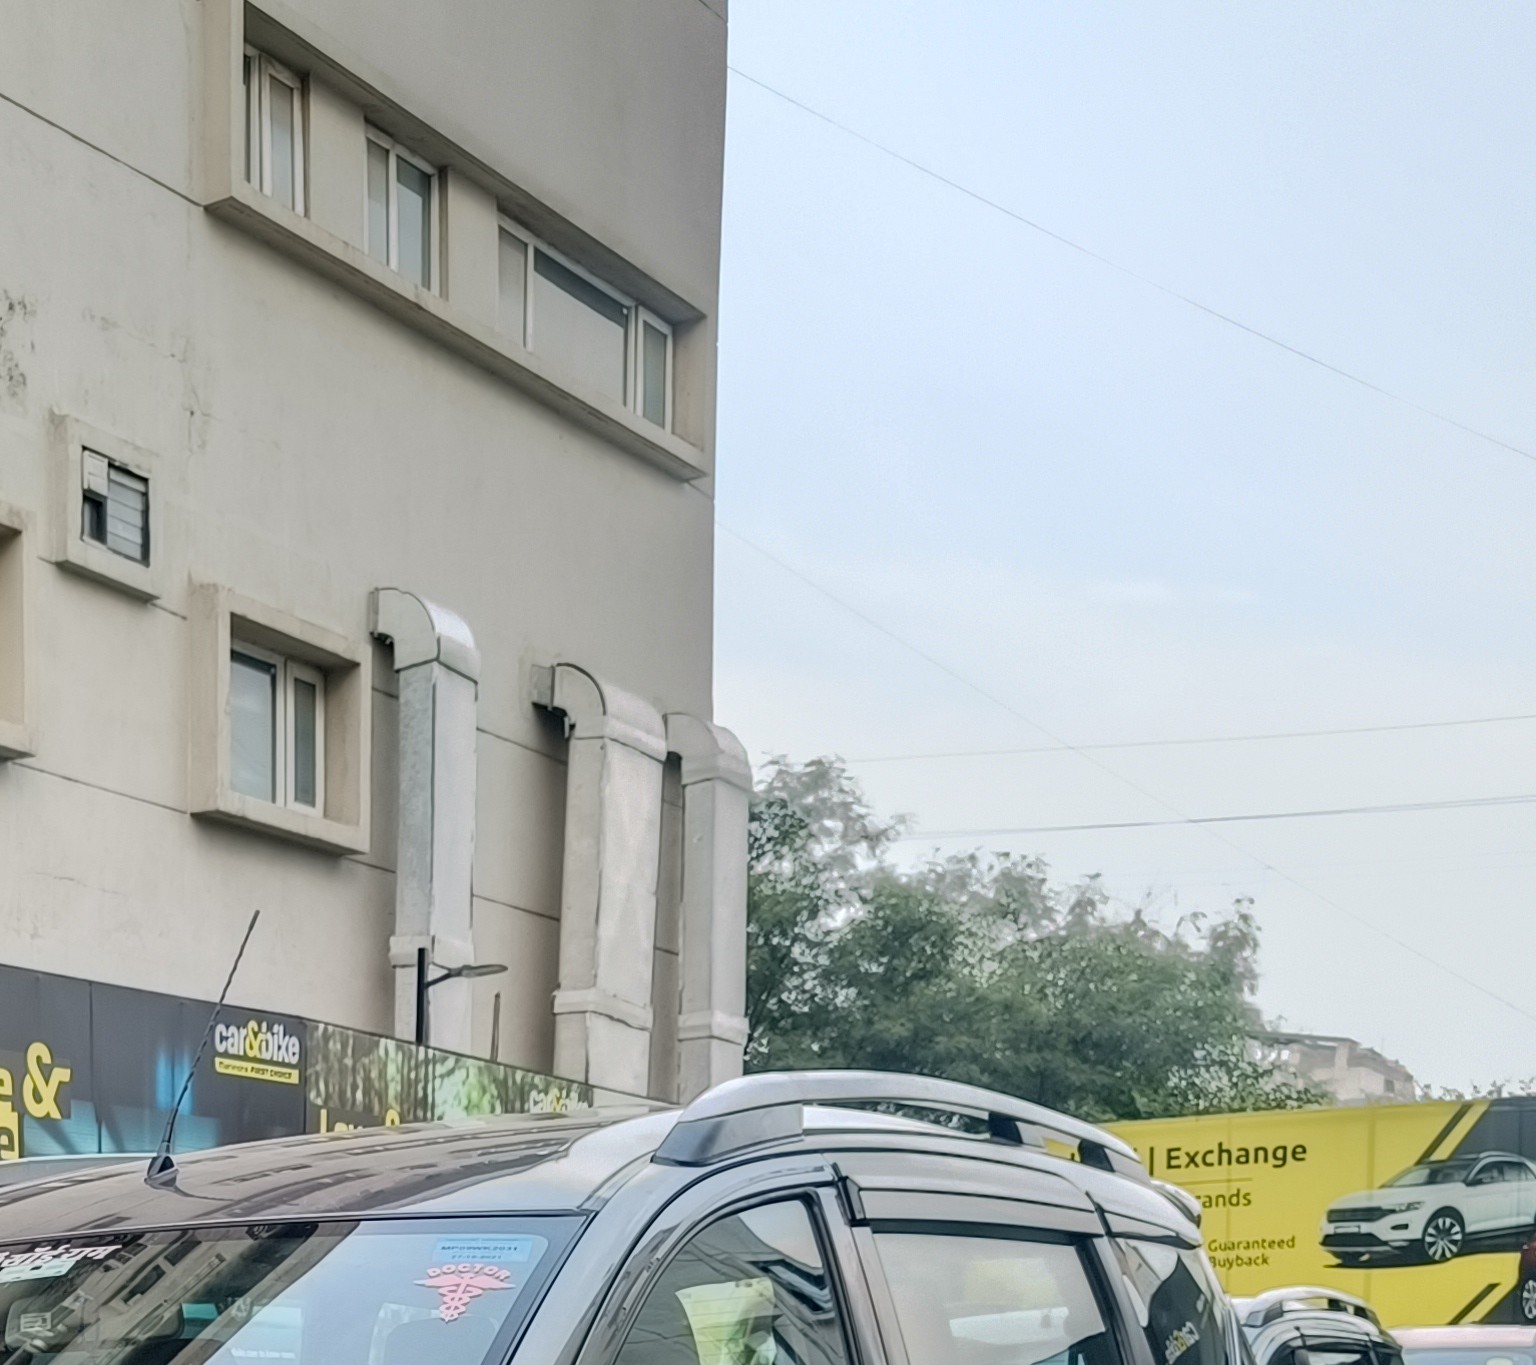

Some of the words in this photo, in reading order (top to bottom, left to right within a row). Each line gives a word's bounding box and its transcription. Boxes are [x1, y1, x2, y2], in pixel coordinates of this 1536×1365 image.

[215, 1019, 300, 1065] car&bike
[22, 1041, 71, 1119] &
[1166, 1141, 1307, 1169] Exchange
[1196, 1188, 1252, 1209] ands
[1207, 1236, 1296, 1253] Guaranteed
[426, 1263, 511, 1281] DOCTOR
